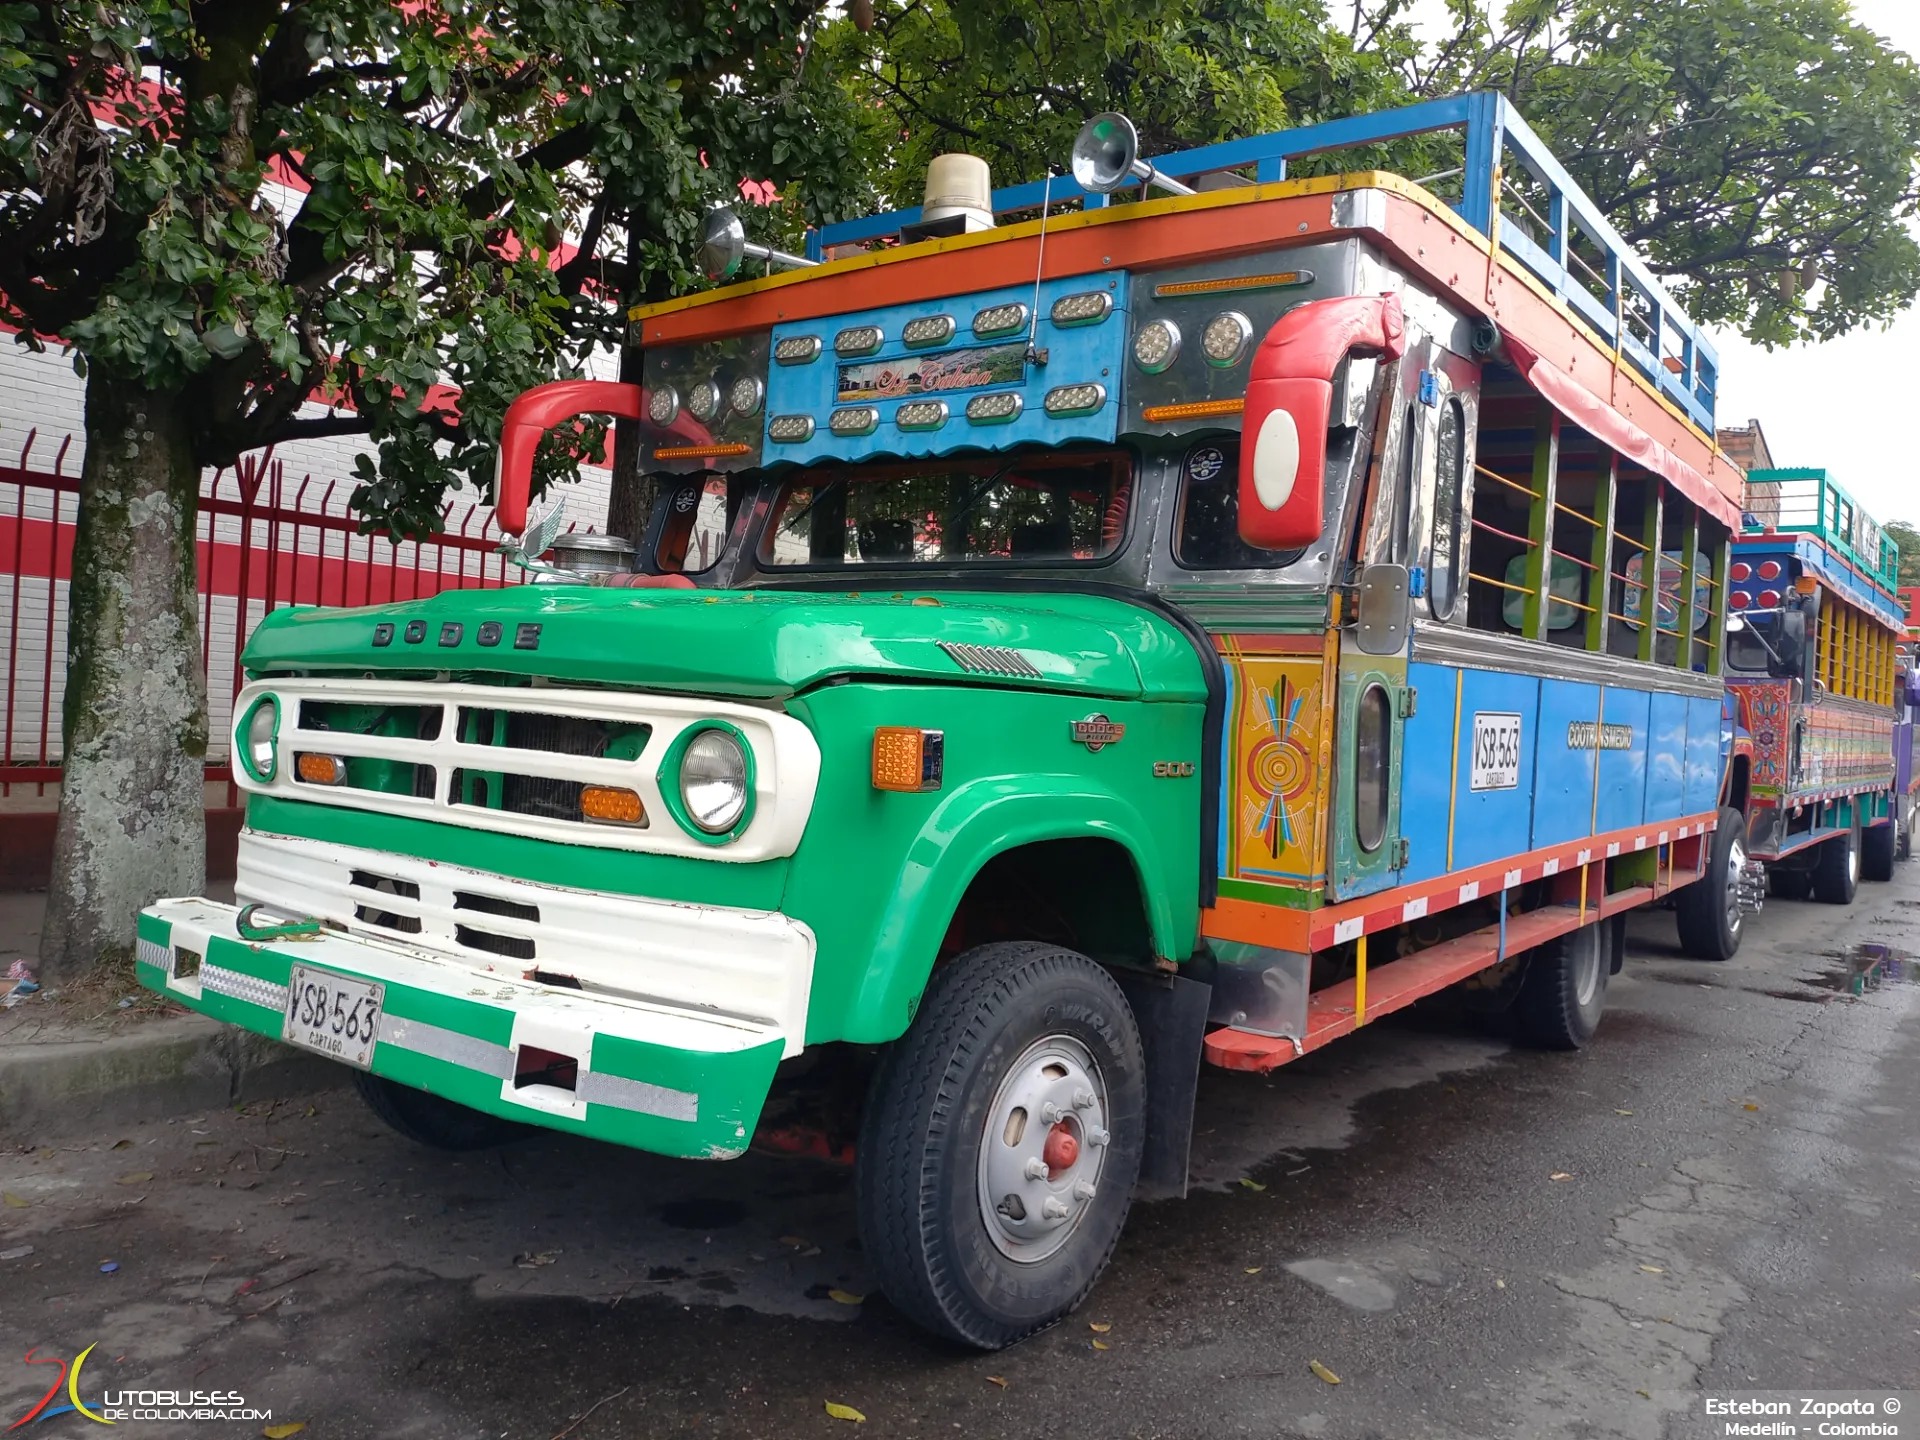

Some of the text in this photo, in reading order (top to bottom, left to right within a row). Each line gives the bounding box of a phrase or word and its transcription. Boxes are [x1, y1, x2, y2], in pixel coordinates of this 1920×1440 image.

[372, 619, 543, 650] DODGE
[1078, 723, 1124, 734] DODGE
[308, 1031, 343, 1053] CARTAGO
